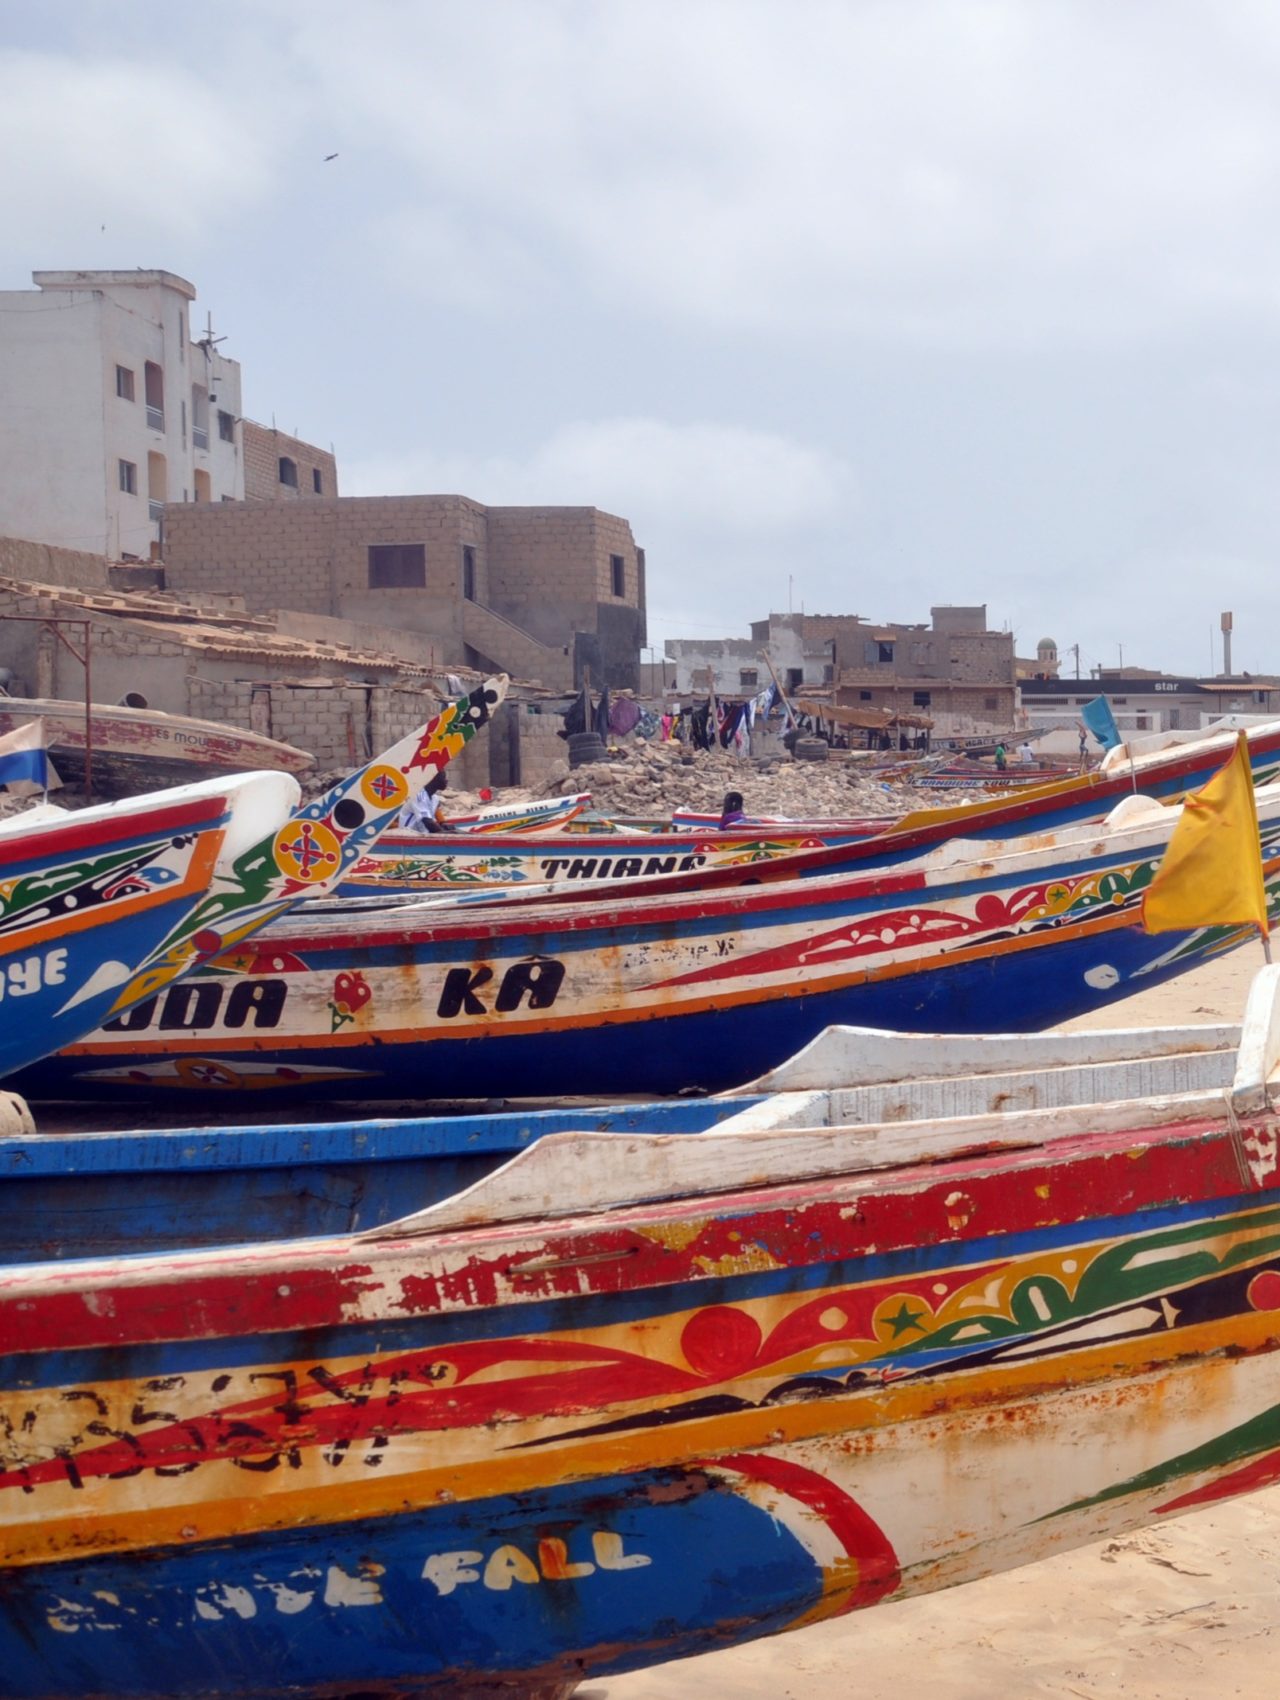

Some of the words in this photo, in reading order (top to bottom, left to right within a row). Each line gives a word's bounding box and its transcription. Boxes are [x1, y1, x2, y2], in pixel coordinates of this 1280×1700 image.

[1155, 682, 1179, 691] star
[0, 948, 68, 1002] YE
[421, 1531, 652, 1596] FALL
